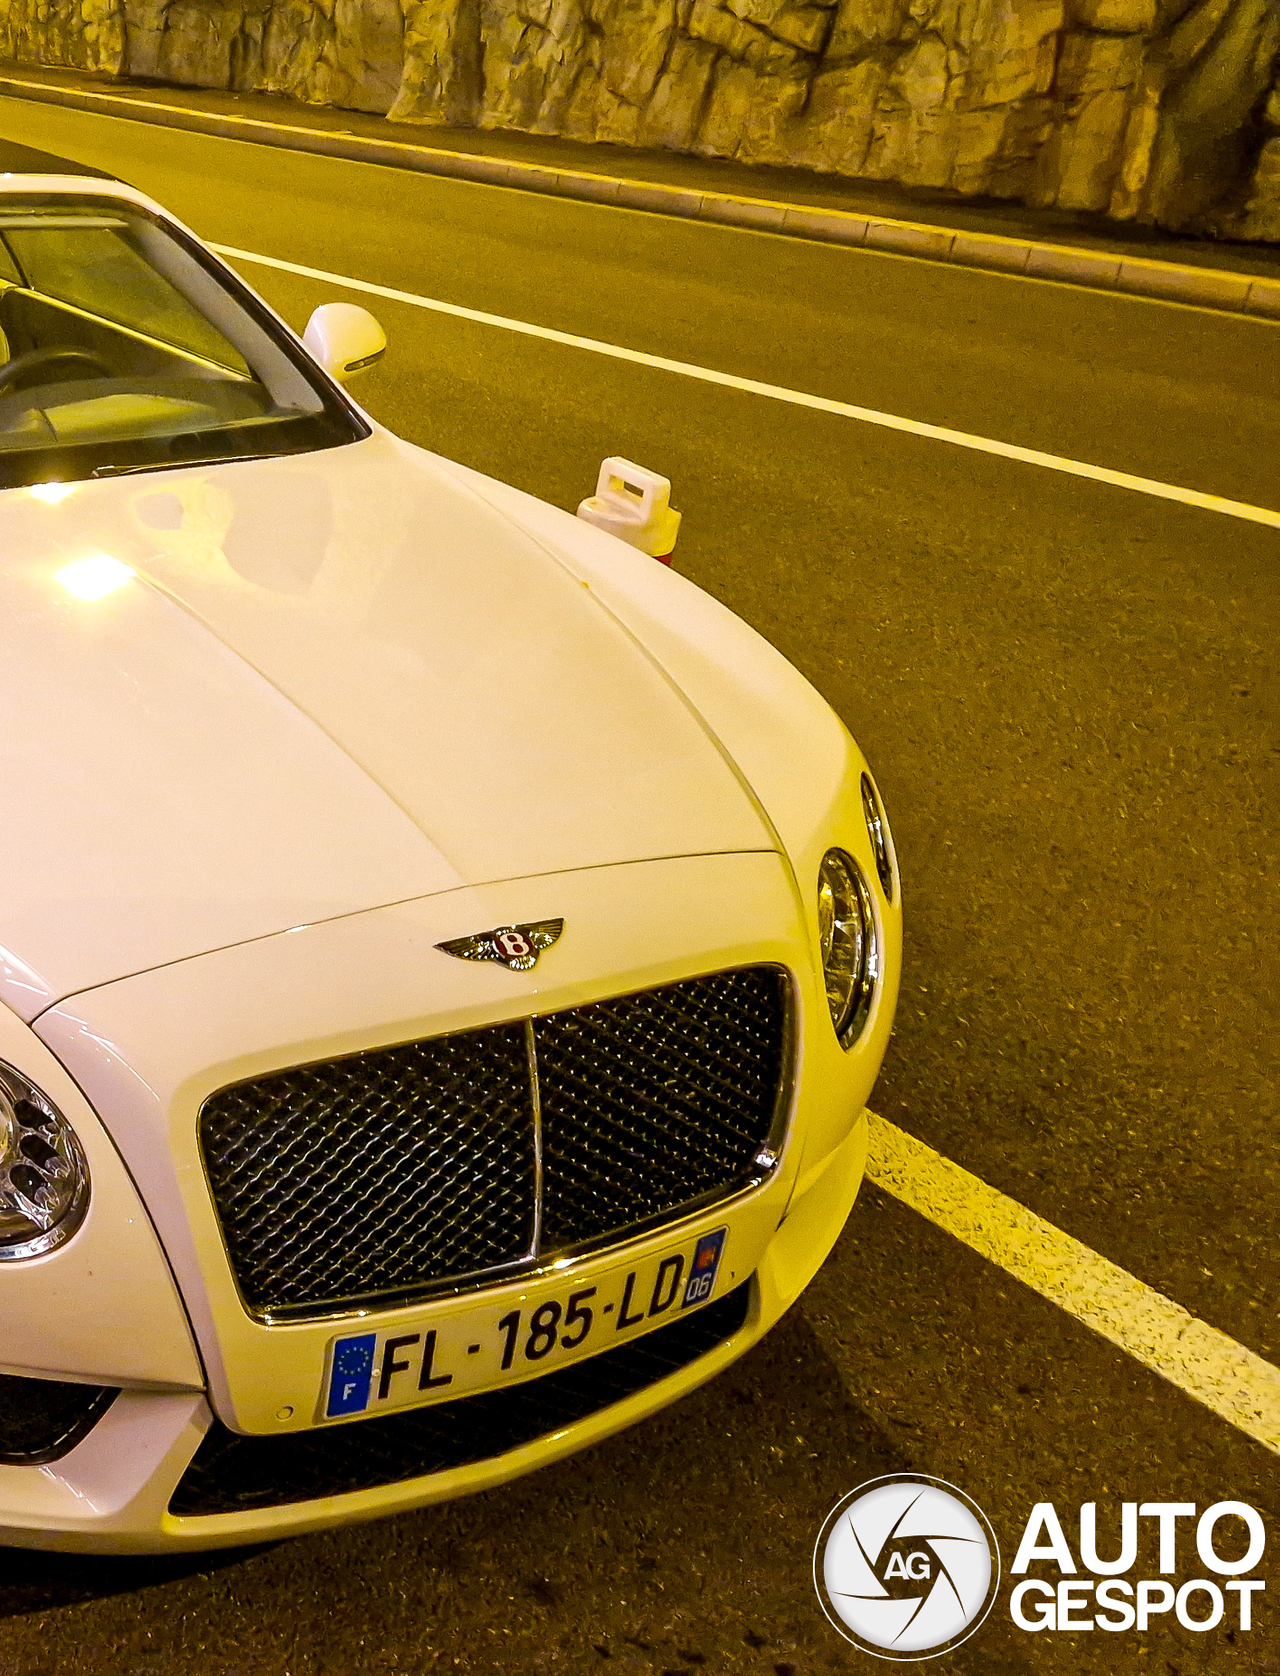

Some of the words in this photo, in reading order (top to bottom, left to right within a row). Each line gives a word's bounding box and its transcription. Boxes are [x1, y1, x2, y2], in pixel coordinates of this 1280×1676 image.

[499, 932, 530, 956] B
[686, 1272, 712, 1301] 06
[342, 1382, 357, 1401] F
